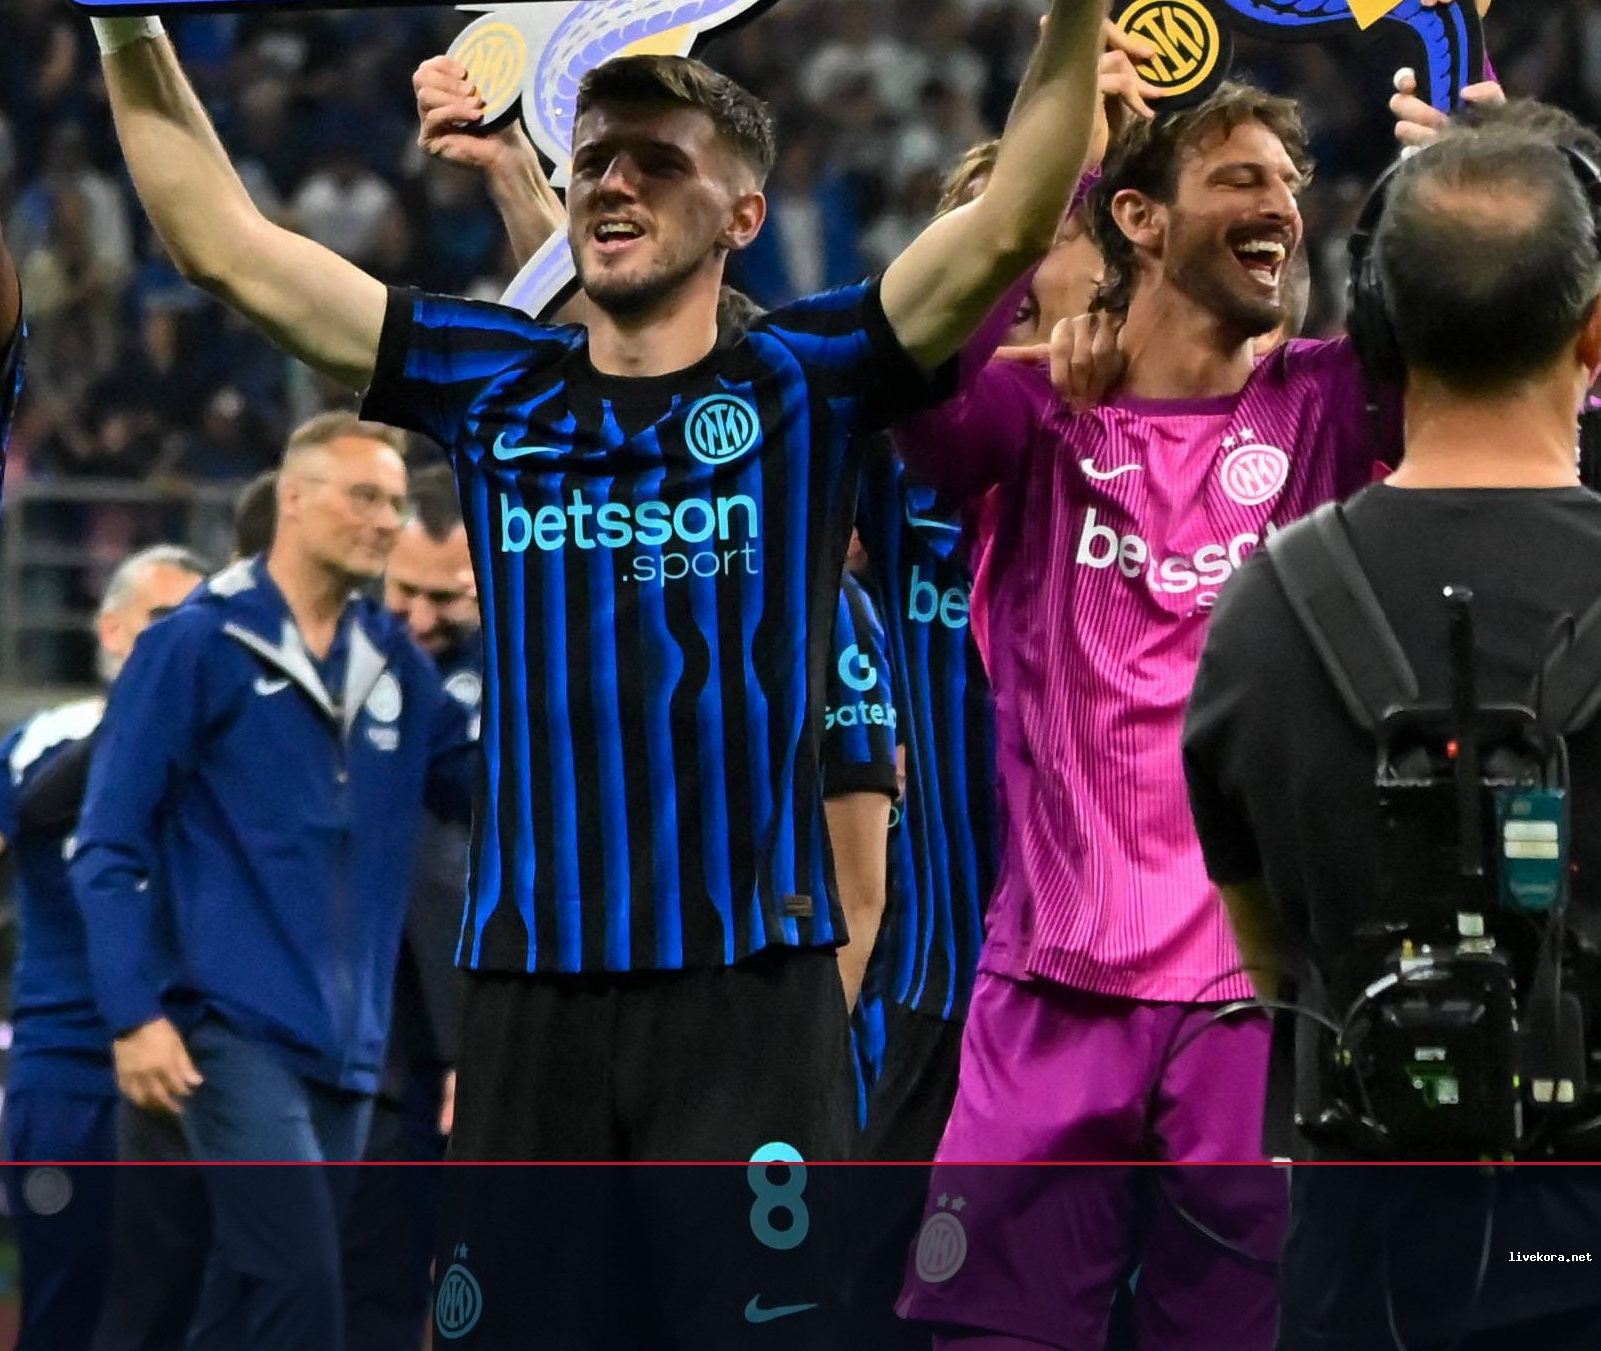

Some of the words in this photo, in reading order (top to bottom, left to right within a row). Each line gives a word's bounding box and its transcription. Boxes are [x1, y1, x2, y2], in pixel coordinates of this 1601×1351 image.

[499, 488, 759, 554] betsson
[621, 540, 760, 589] .sport
[746, 1140, 809, 1250] 8
